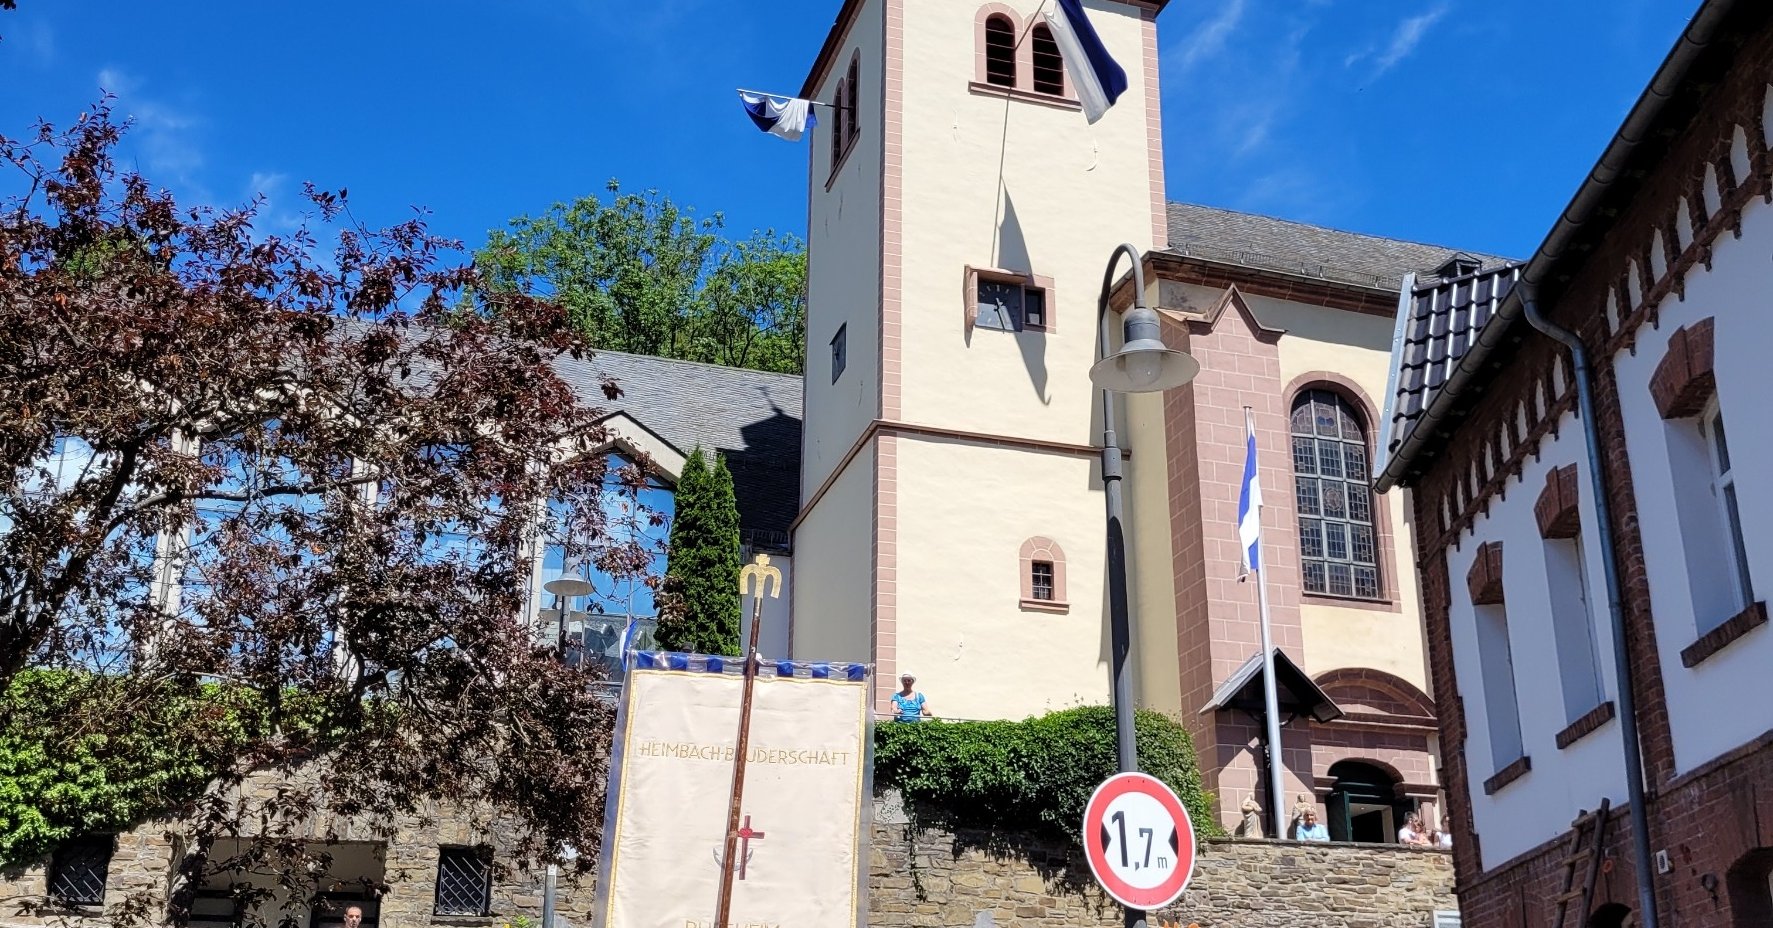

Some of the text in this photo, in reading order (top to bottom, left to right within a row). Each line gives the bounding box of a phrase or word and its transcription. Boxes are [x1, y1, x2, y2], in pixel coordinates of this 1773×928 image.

[640, 742, 850, 766] HEIMBACH-BUDERSCHAFT
[1111, 810, 1168, 872] 1,7 m
